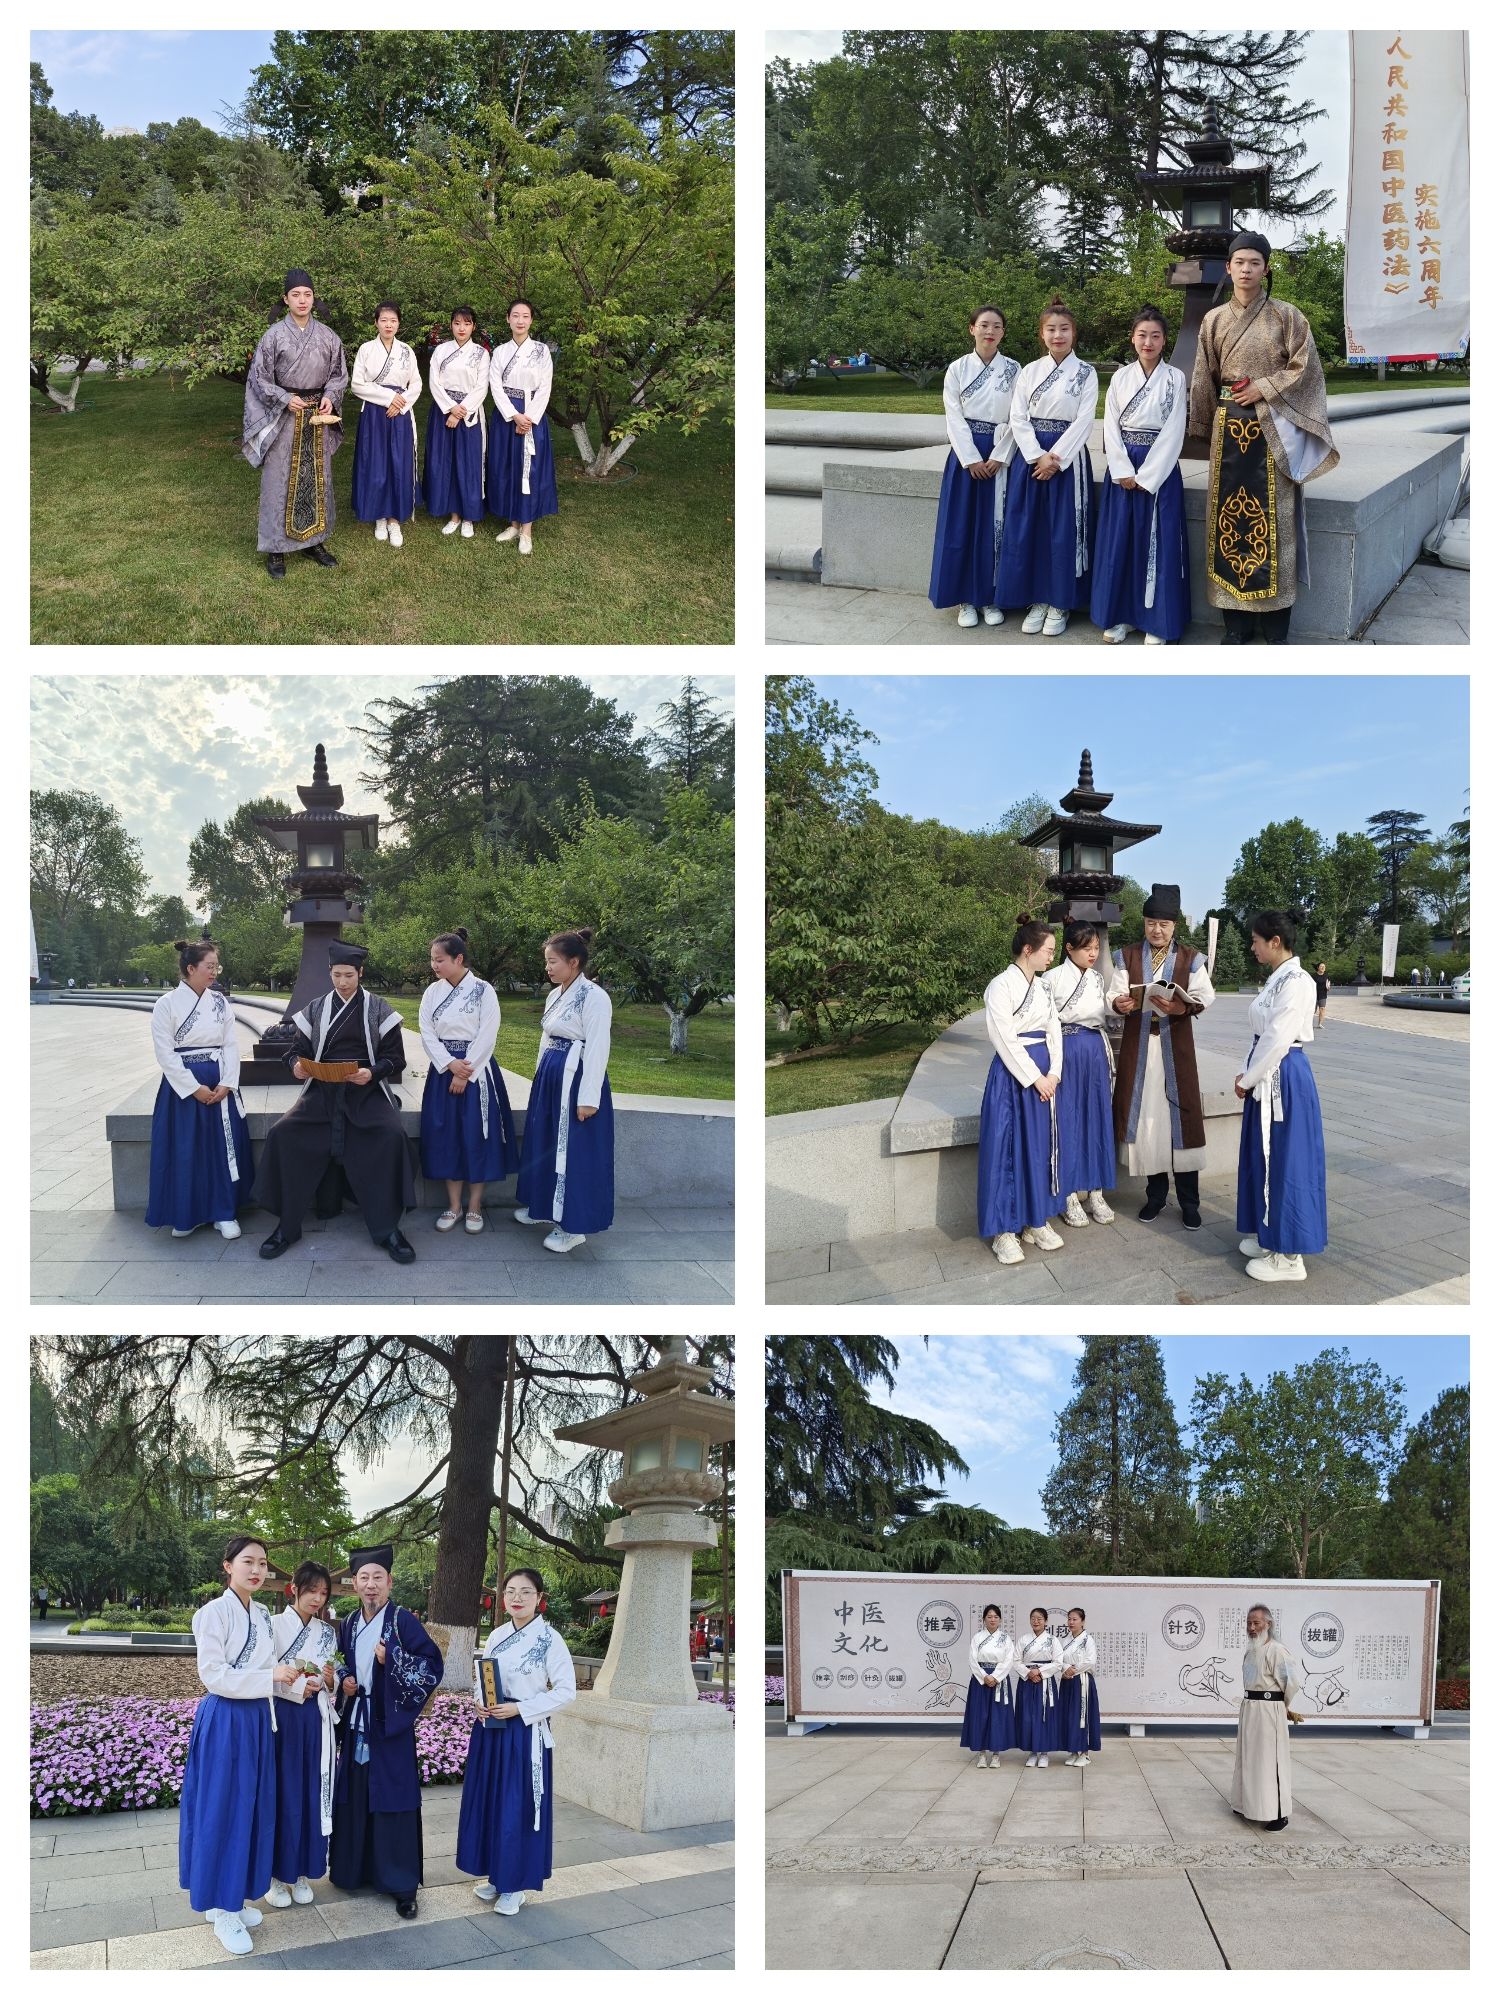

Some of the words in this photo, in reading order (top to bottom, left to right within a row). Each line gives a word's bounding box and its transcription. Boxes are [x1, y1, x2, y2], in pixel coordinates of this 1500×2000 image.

[1382, 36, 1412, 295] 人民共和国中医药法》
[1414, 184, 1443, 310] 实施六周年
[833, 1600, 886, 1627] 中医
[924, 1616, 957, 1632] 推拿
[1167, 1620, 1198, 1635] 针灸
[1307, 1628, 1338, 1642] 拔罐
[831, 1632, 889, 1656] 文化
